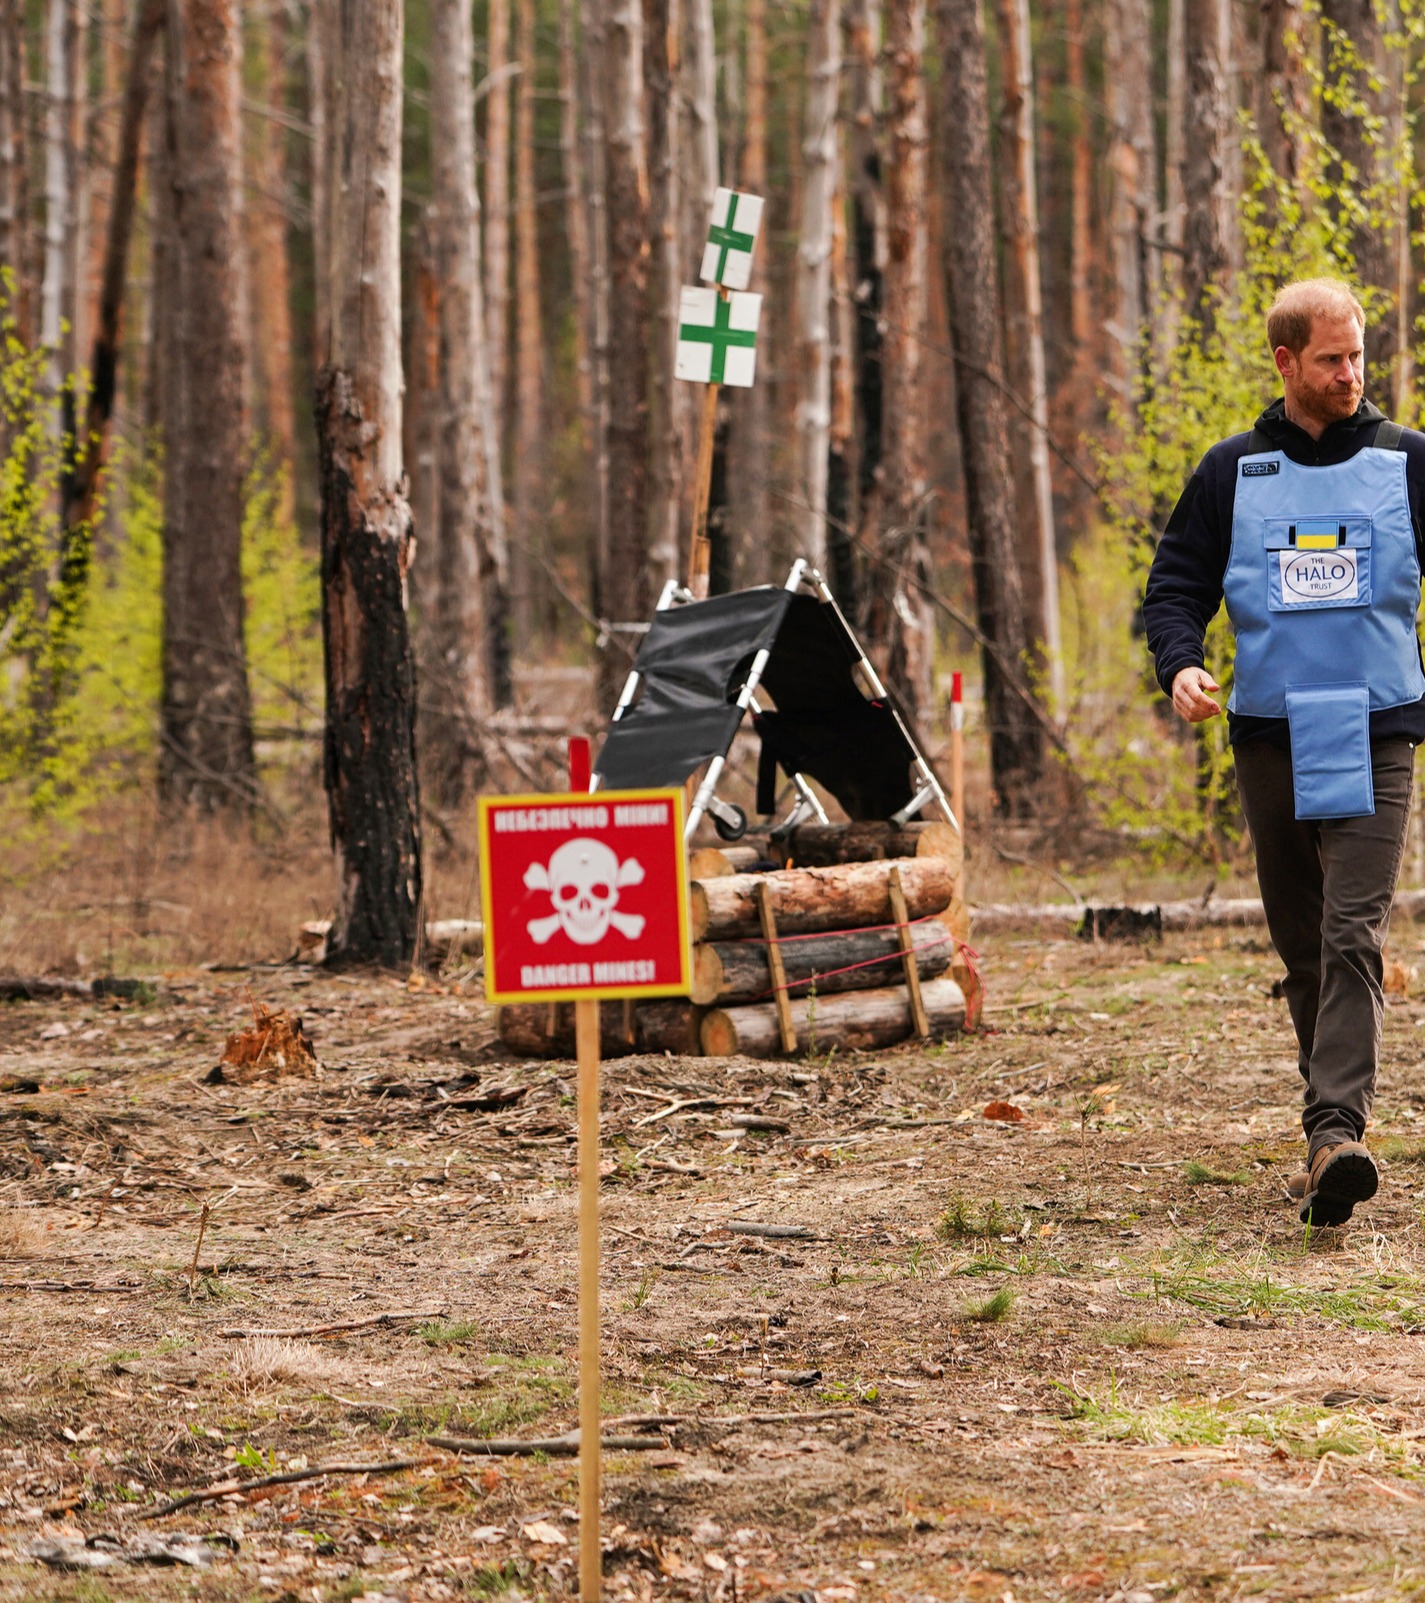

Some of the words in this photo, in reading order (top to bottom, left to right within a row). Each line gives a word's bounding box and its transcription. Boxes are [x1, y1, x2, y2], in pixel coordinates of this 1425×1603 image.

[1311, 557, 1325, 565] THE
[1296, 564, 1346, 582] HALO
[1310, 582, 1332, 590] TRUST
[494, 806, 609, 833] НЕБЕЗПЕЧНО
[521, 963, 591, 987] DANGER
[592, 959, 656, 984] MINES!
